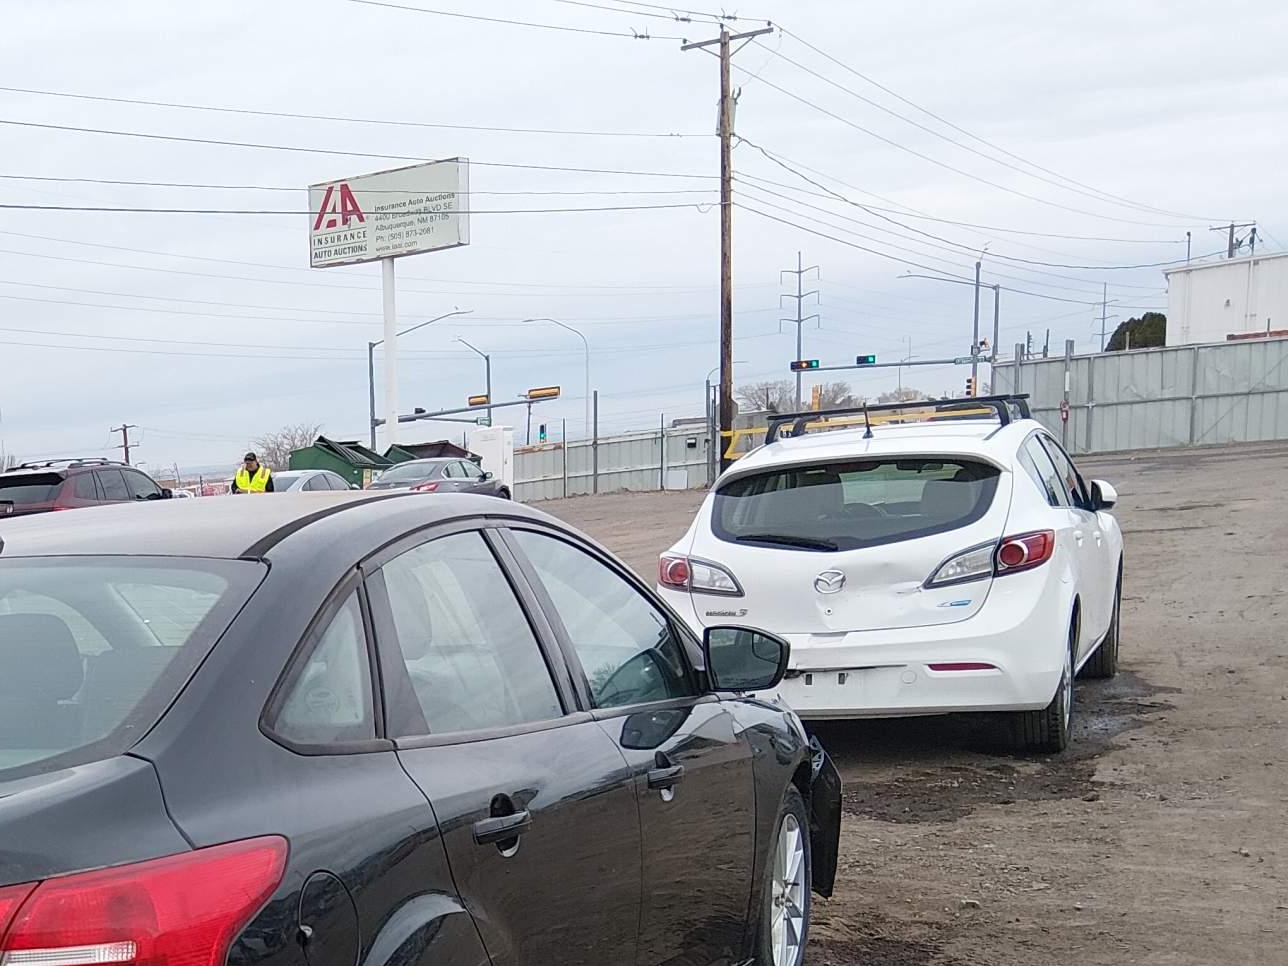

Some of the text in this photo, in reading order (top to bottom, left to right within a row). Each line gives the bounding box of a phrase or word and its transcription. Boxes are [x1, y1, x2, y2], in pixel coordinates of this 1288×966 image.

[375, 192, 456, 212] Insurance Auto Auctions
[443, 201, 453, 210] SE
[417, 216, 428, 224] NM
[313, 231, 367, 247] INSURANCE
[314, 244, 368, 260] AUTO AUCTIONS
